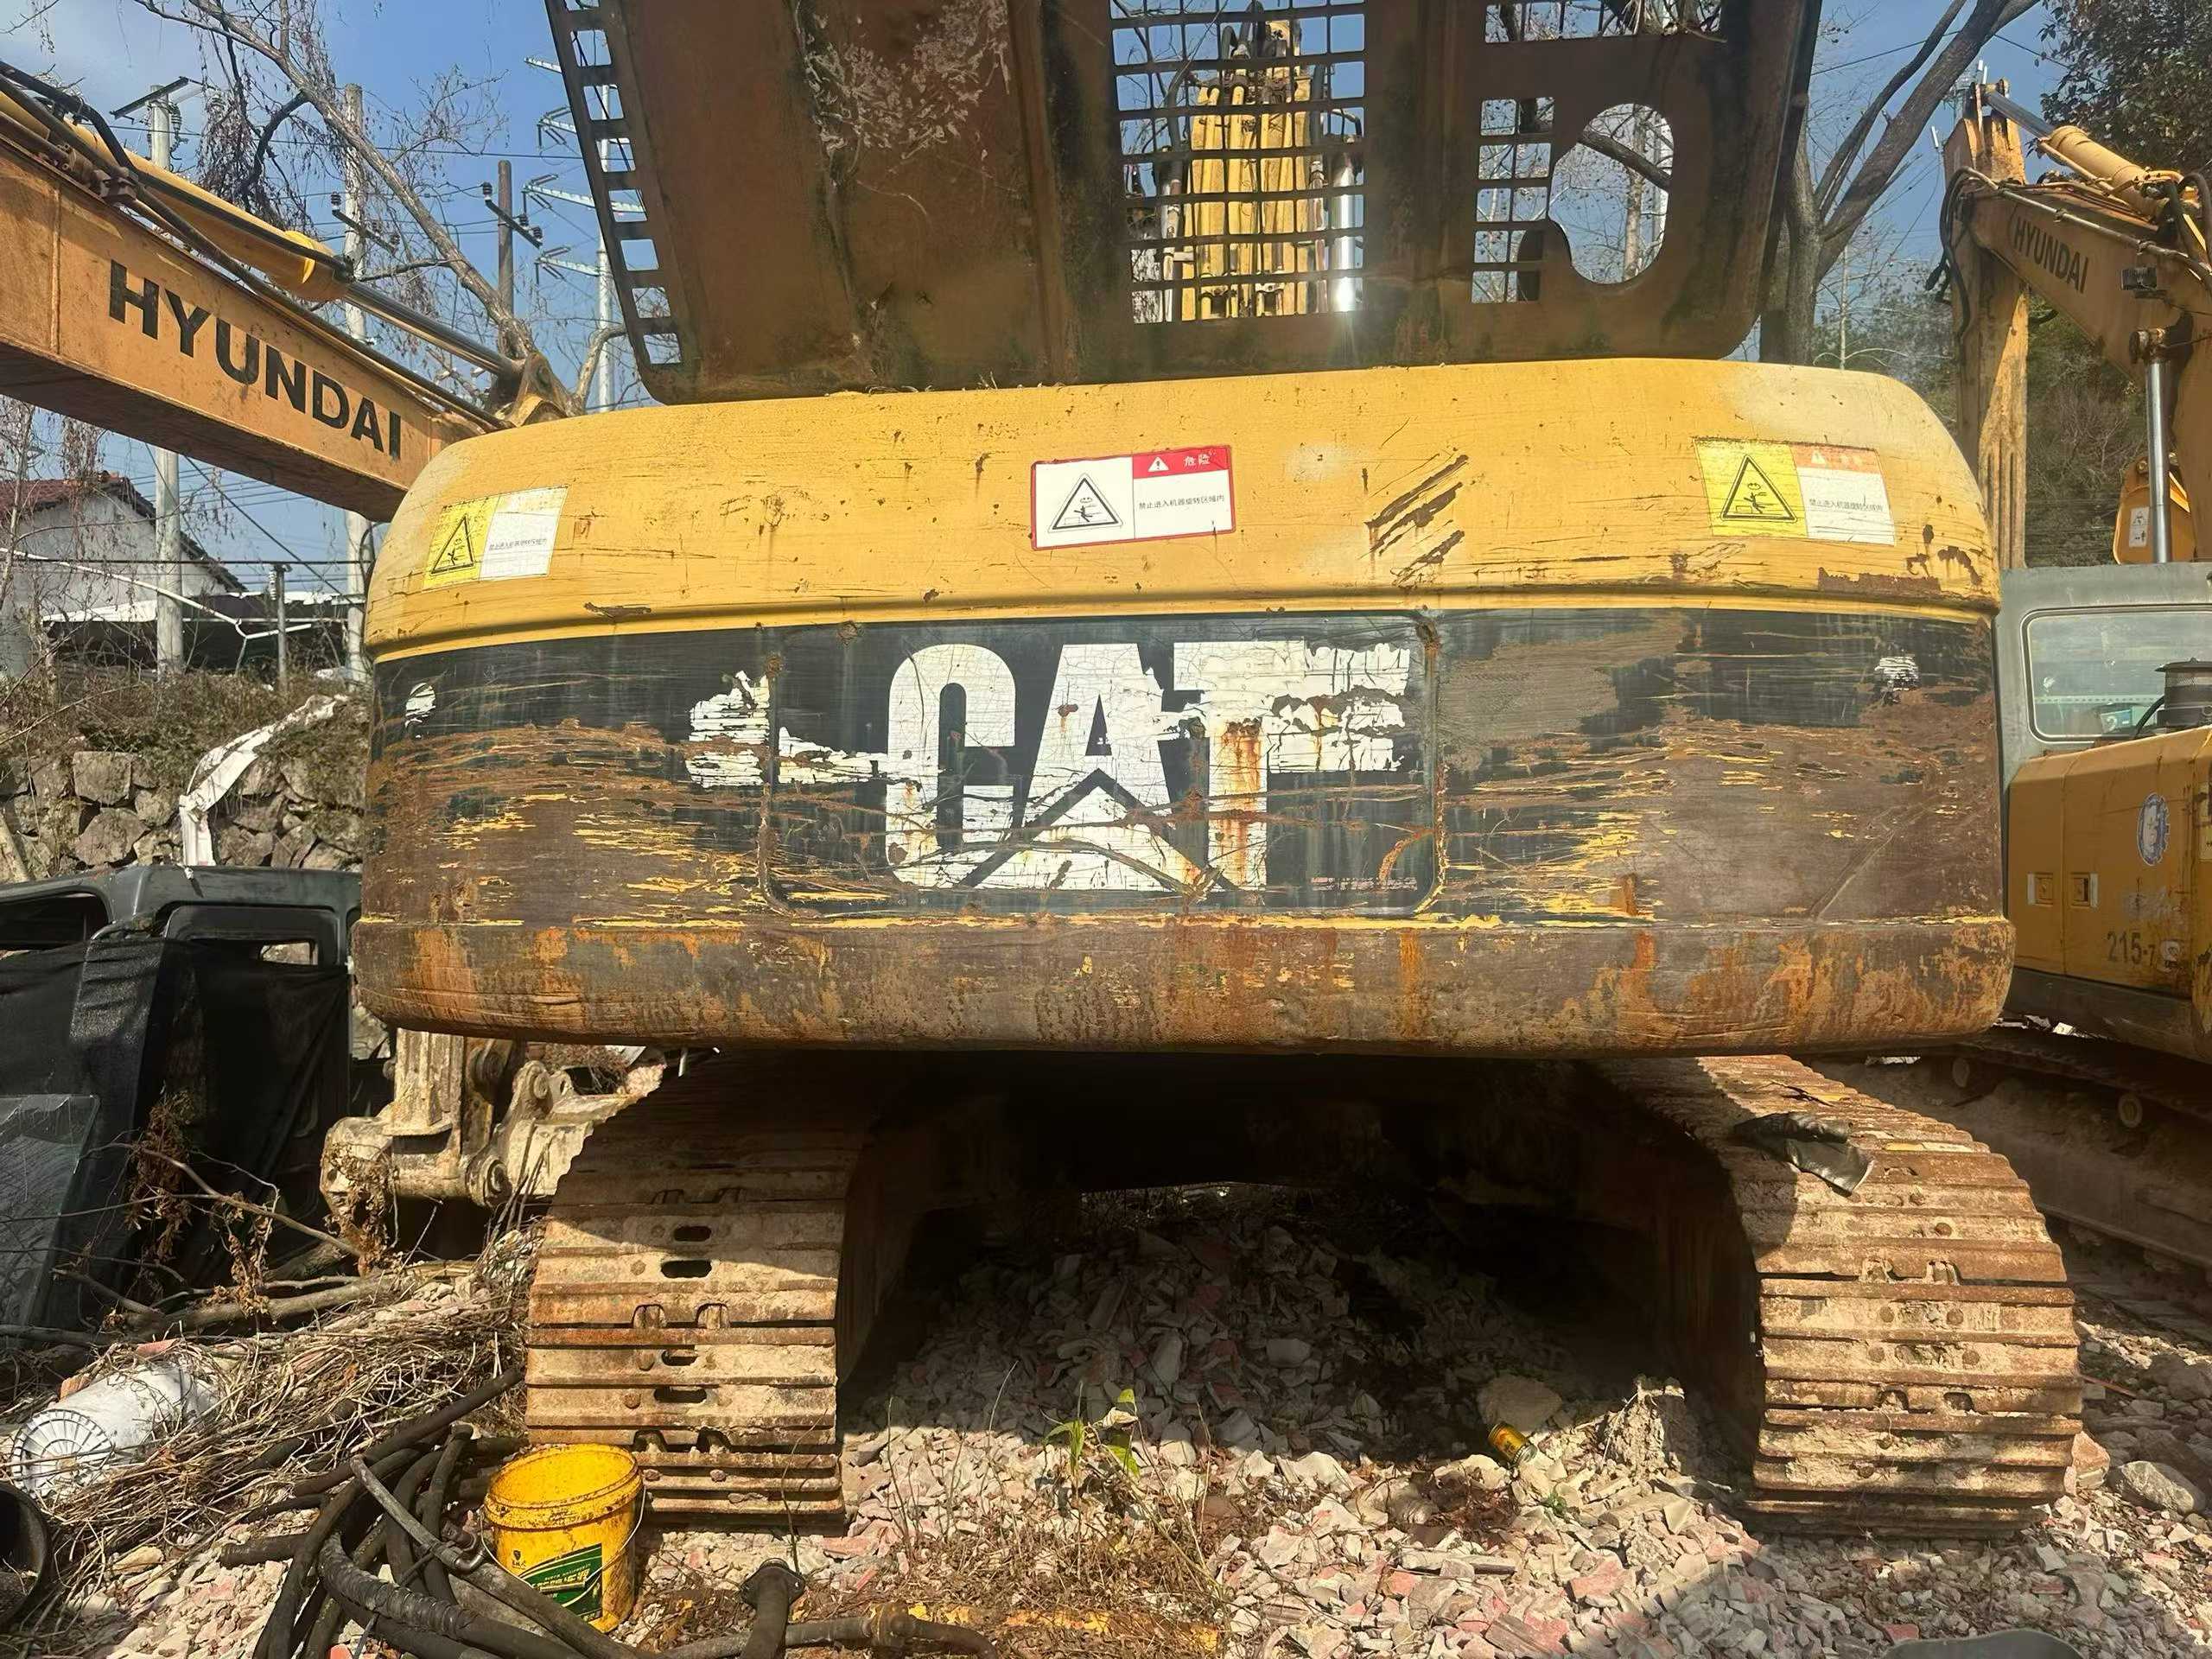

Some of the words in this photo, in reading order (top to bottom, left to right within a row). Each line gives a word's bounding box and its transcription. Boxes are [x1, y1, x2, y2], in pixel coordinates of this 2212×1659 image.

[2013, 219, 2088, 293] HYUNDAI
[109, 259, 402, 461] HYUNDAI
[1183, 454, 1211, 467] 危险
[885, 643, 1306, 892] CAT
